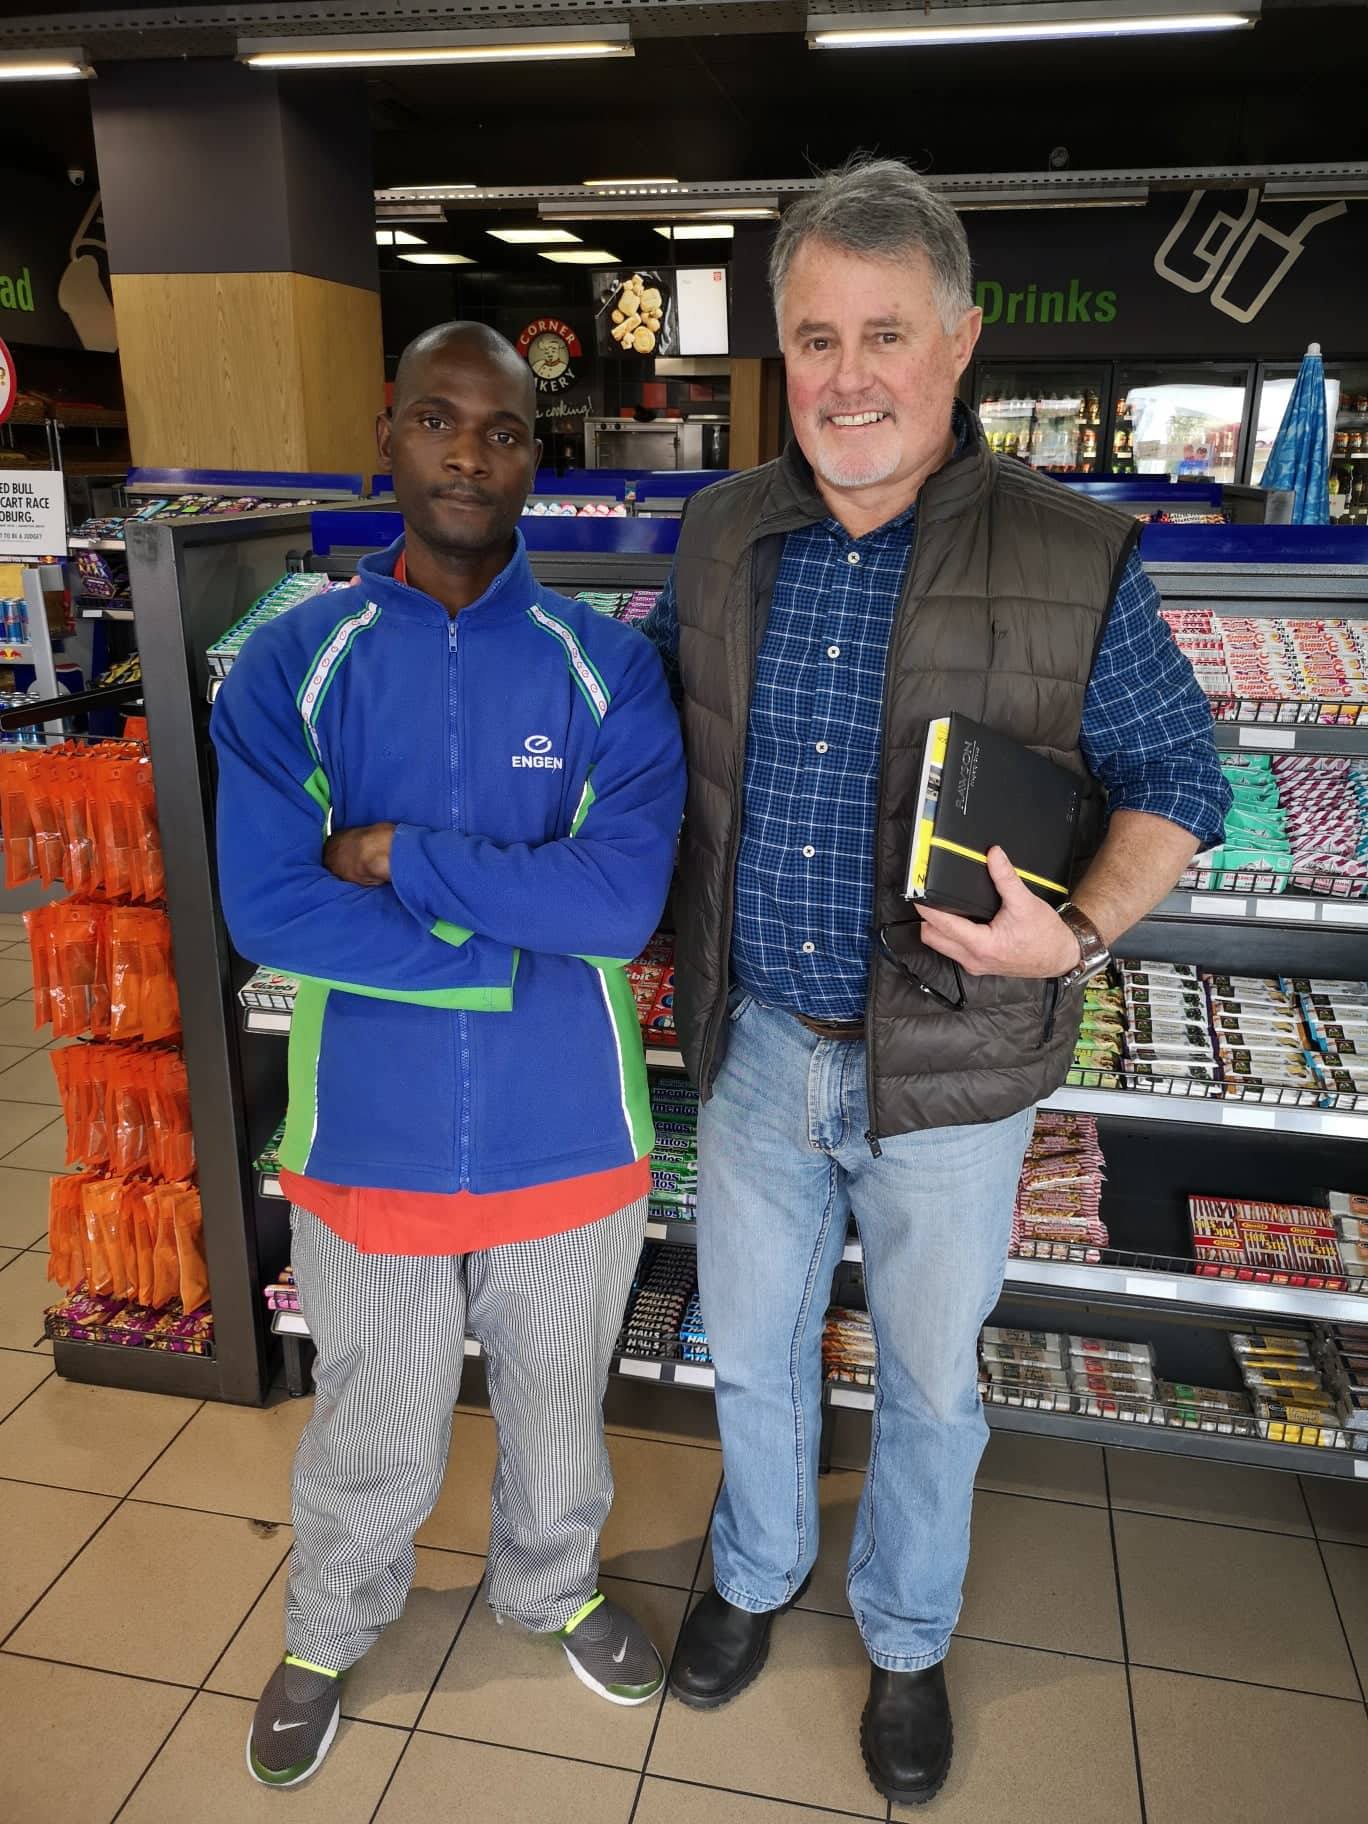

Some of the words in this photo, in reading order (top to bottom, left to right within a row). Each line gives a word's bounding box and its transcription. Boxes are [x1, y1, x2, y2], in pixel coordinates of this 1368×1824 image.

[976, 279, 1118, 324] Drinks
[520, 320, 575, 345] CORNER
[12, 483, 35, 495] BULL
[0, 497, 23, 508] CART
[26, 497, 50, 509] RACE
[511, 756, 563, 769] ENGEN
[655, 1121, 690, 1133] entos
[628, 1320, 661, 1329] HALLS
